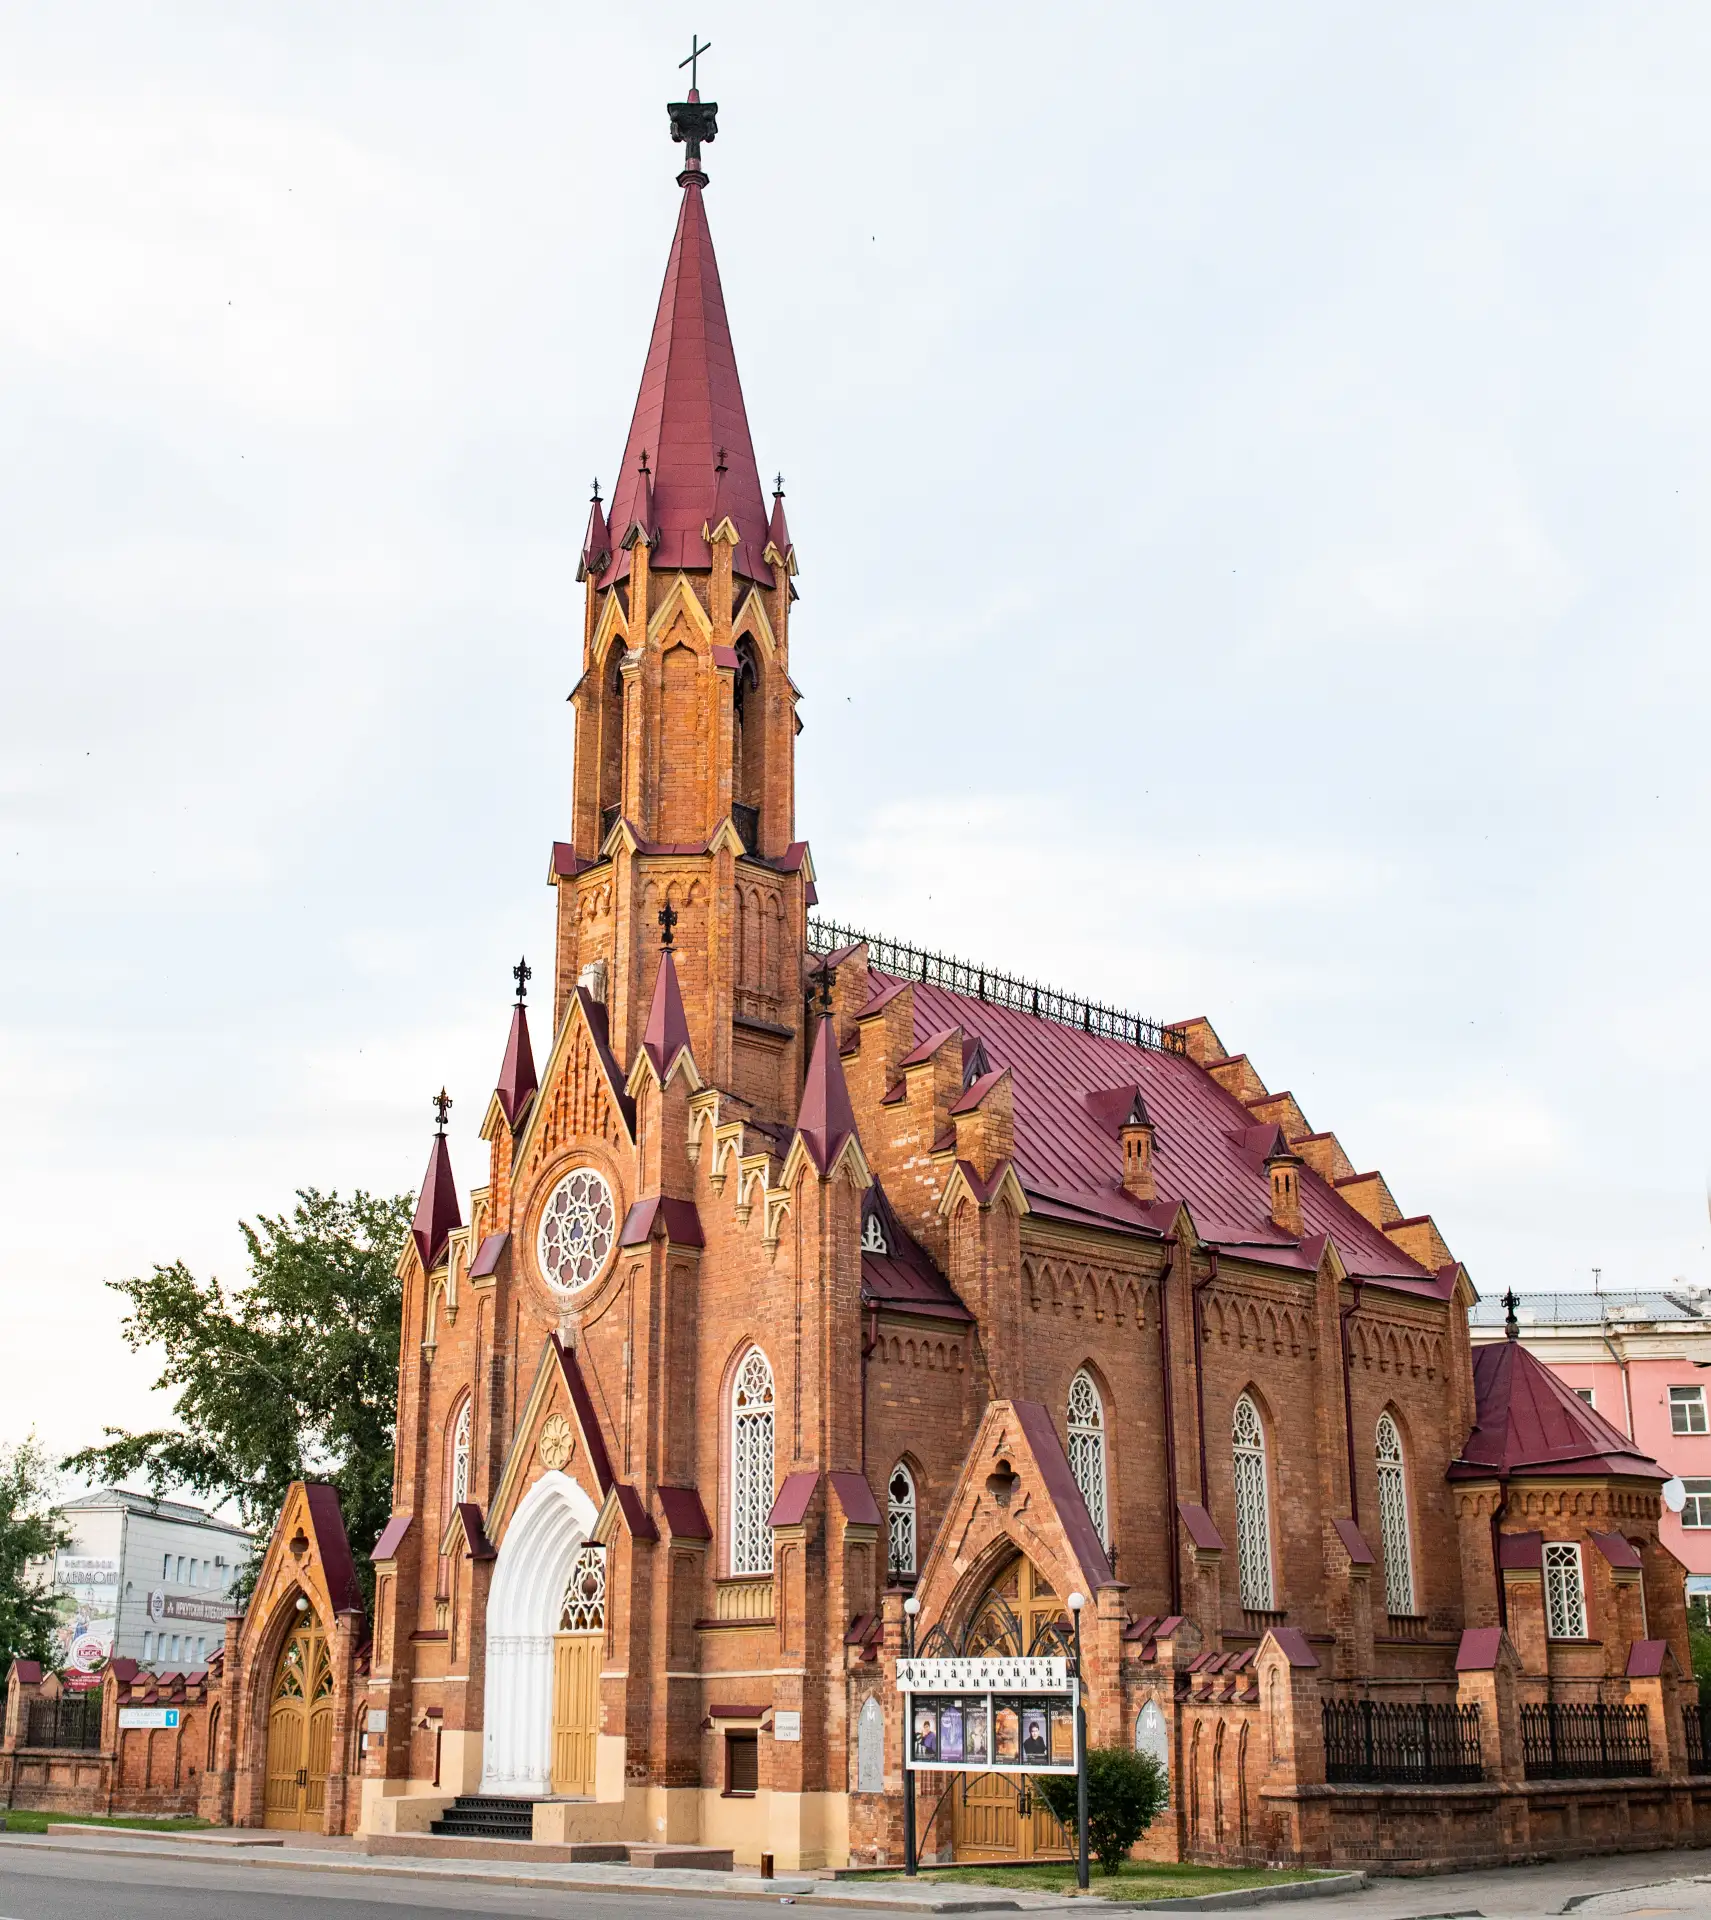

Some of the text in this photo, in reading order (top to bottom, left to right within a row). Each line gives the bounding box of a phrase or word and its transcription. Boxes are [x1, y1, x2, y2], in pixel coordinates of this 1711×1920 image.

[176, 1602, 204, 1617] ИРКУТСКИЙ
[1039, 1678, 1062, 1687] зал
[168, 1713, 174, 1724] 1
